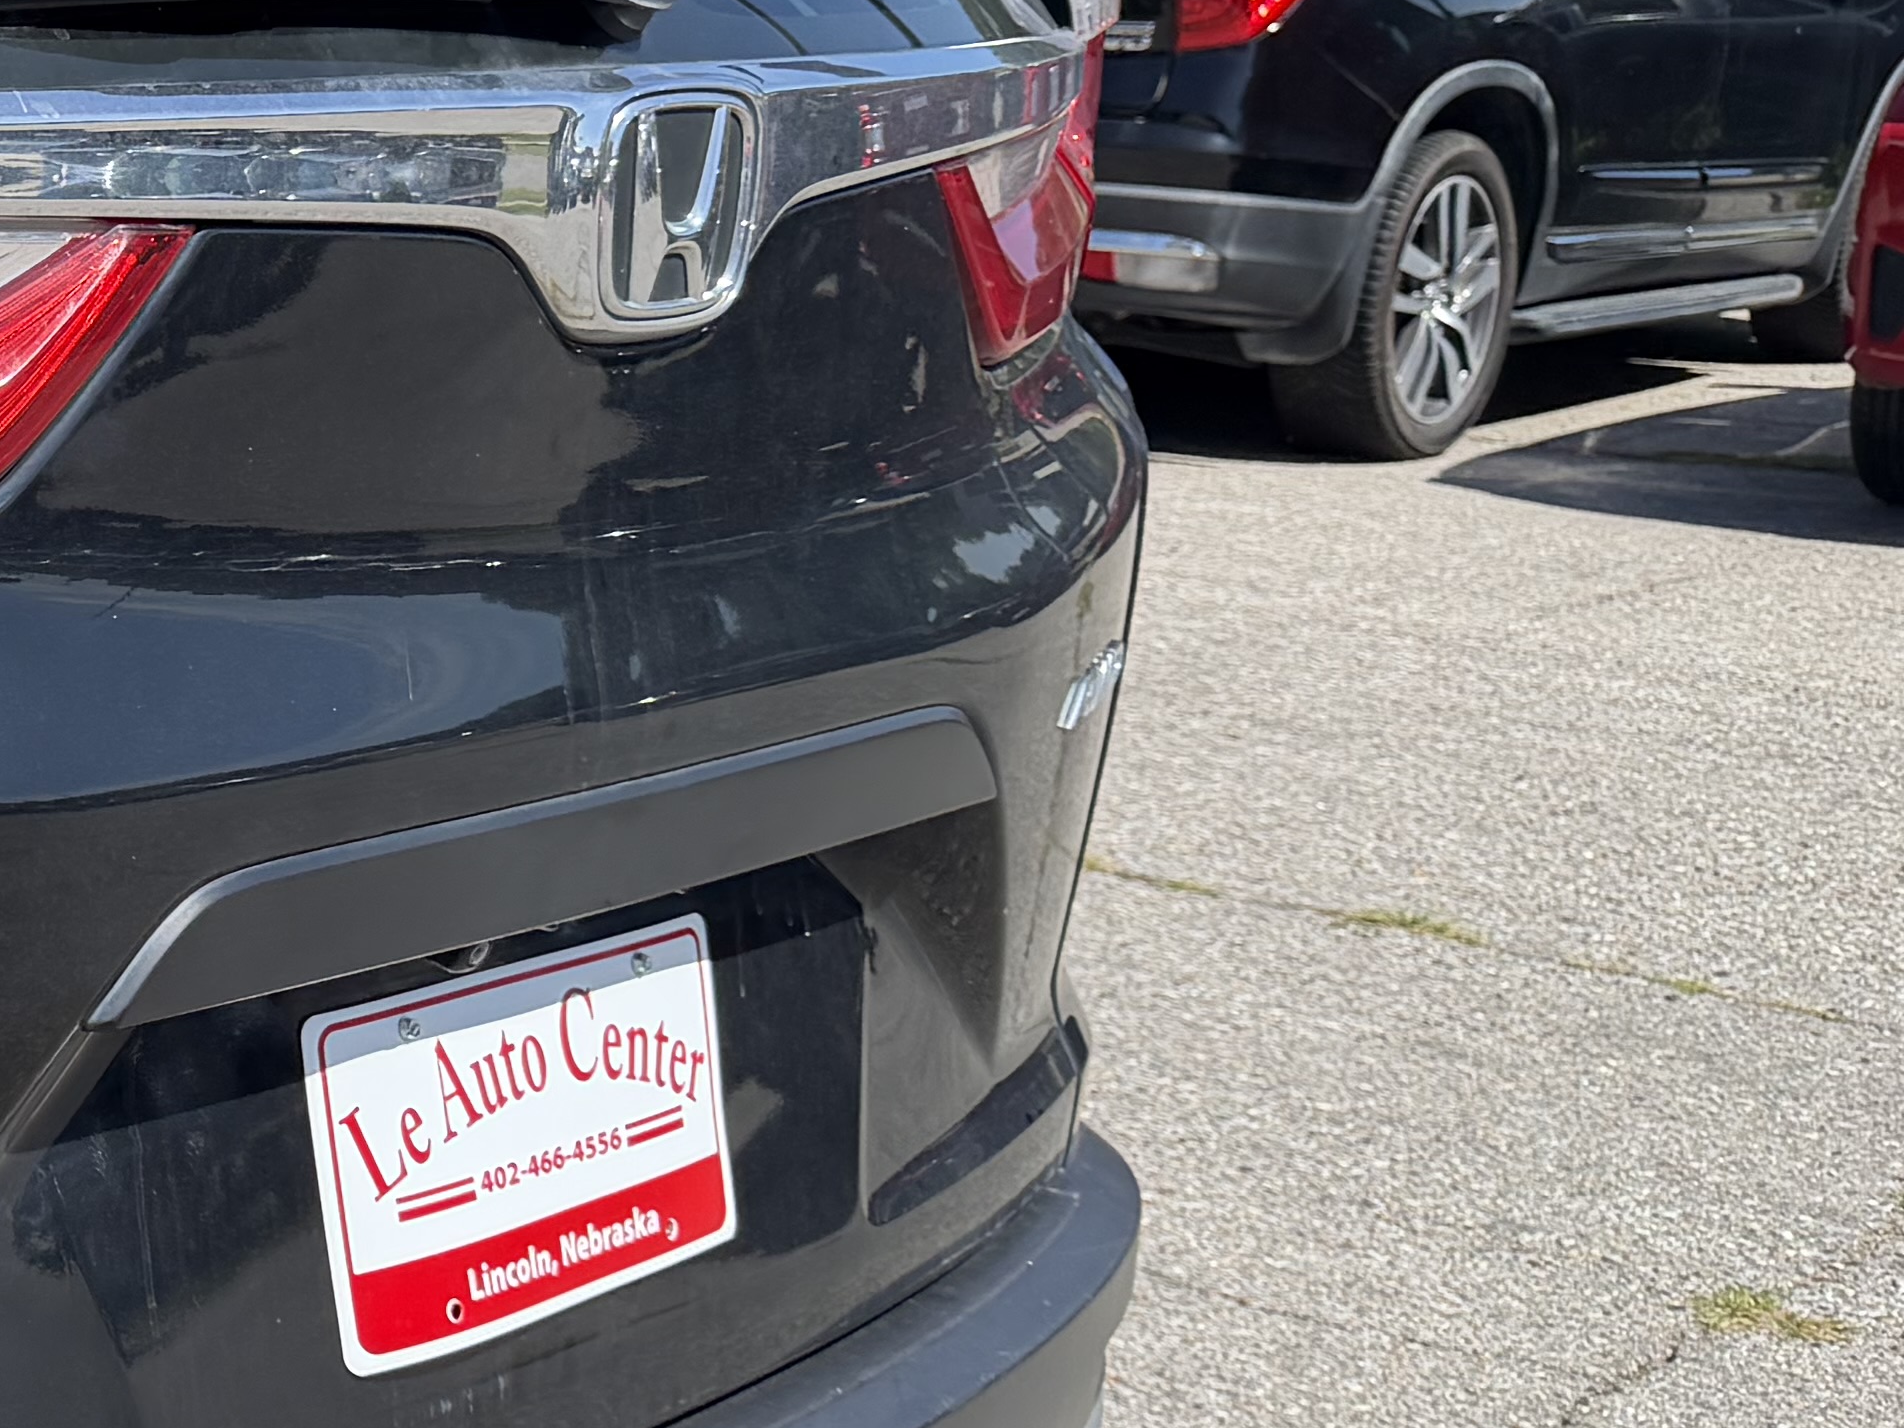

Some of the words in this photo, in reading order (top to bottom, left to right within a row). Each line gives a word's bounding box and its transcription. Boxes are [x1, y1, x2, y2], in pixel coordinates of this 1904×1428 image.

[339, 1107, 432, 1202] Le
[435, 1029, 548, 1144] Auto
[559, 987, 705, 1102] Center
[480, 1127, 622, 1194] 402-466-4556
[466, 1244, 559, 1302] Lincoln,
[559, 1206, 661, 1267] Nebraska
